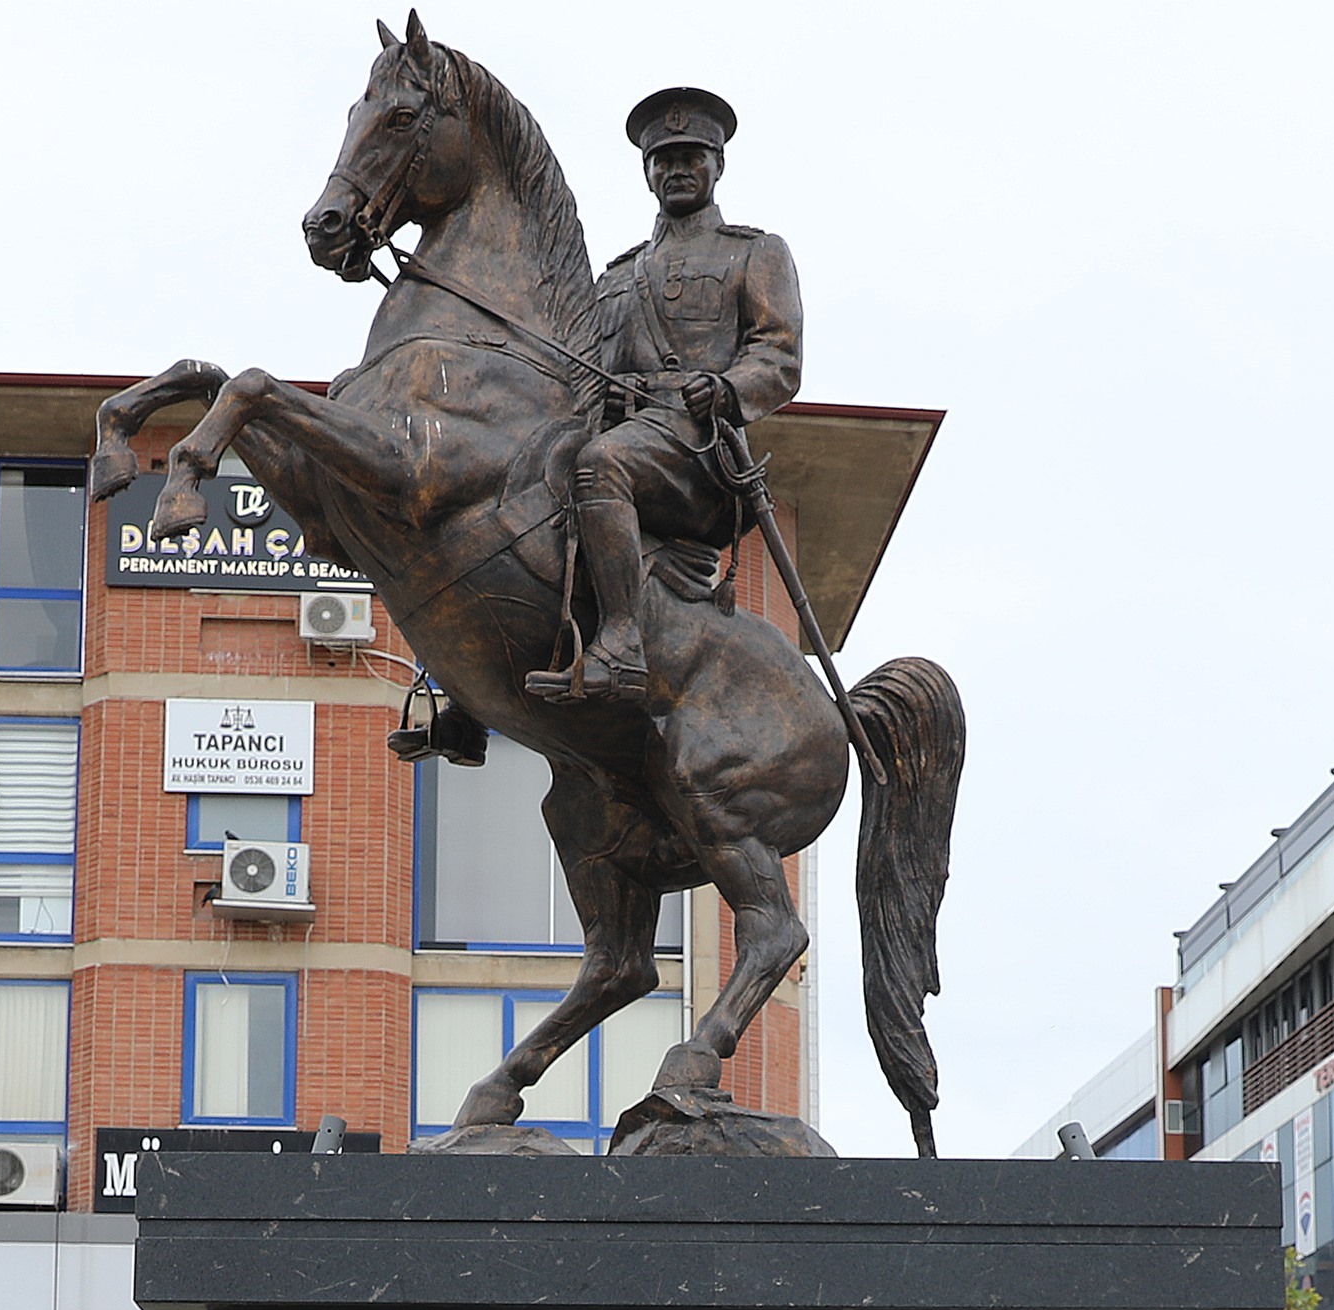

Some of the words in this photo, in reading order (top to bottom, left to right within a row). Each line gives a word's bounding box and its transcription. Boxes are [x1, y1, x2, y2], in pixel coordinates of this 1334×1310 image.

[119, 557, 218, 575] PERMANENT
[221, 559, 289, 577] MAKEUP
[292, 561, 305, 578] &
[193, 733, 284, 753] TAPANCI
[171, 757, 231, 769] HUKUK
[236, 757, 304, 771] BÜROSU
[285, 847, 298, 896] BEKO
